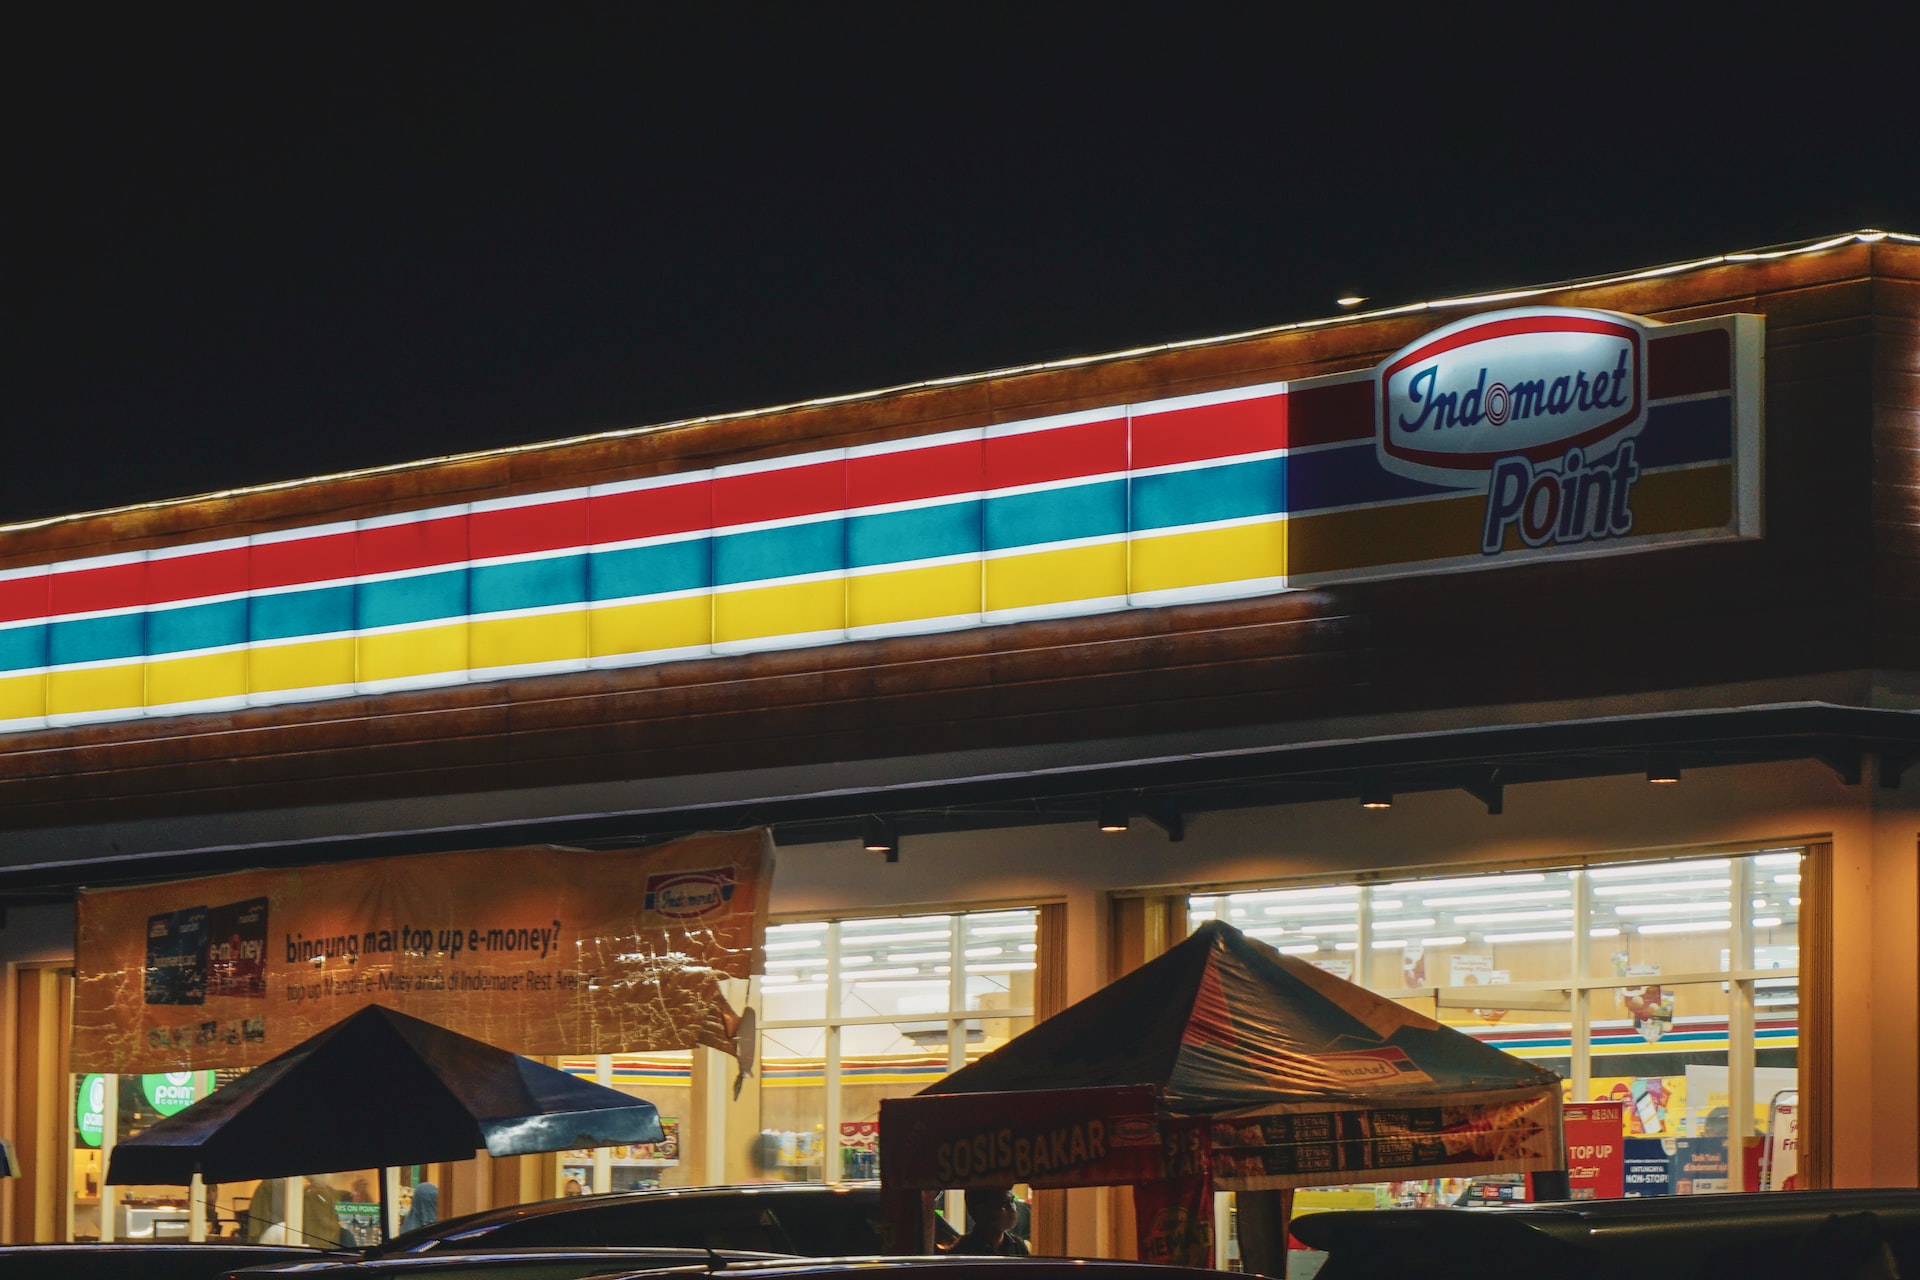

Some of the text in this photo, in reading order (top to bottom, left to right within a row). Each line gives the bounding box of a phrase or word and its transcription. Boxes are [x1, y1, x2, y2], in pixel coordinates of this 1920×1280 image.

[1400, 349, 1628, 433] Indomaret
[1482, 440, 1639, 555] Point
[286, 933, 359, 964] bingung
[402, 924, 433, 957] top
[438, 927, 464, 959] up
[468, 920, 561, 958] e-money?
[938, 1127, 1012, 1182] SOSIS
[1015, 1119, 1106, 1178] BAKAR
[1569, 1145, 1613, 1159] TOP UP
